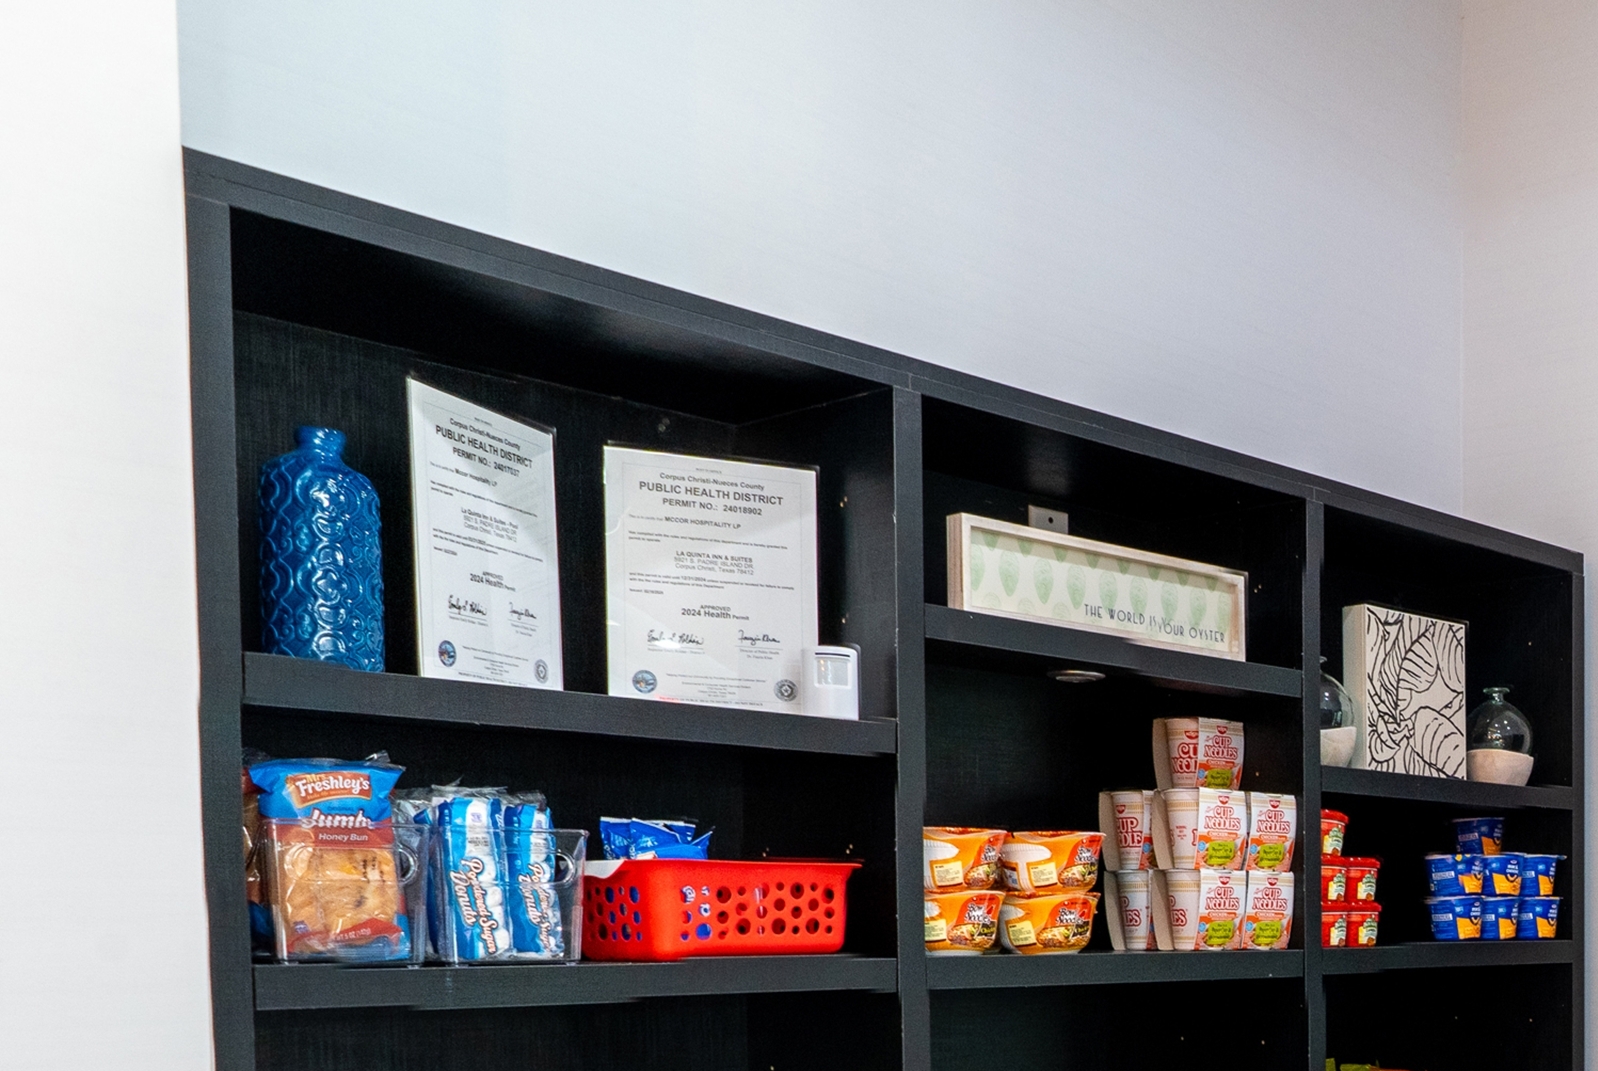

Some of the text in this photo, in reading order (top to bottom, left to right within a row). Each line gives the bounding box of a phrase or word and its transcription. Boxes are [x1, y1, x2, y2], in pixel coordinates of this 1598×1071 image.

[436, 424, 533, 468] PUBLIC HEALTH DISTRICT
[453, 446, 477, 462] PERMIT
[660, 472, 765, 491] Corpus Christi-Nueces County
[639, 481, 783, 505] PUBLIC HEALTH DISTRICT
[662, 498, 697, 508] PERMIT
[723, 504, 763, 516] 24018902
[690, 518, 731, 528] HOSPITALITY
[686, 551, 711, 559] QUINTA
[681, 608, 702, 617] 2024
[703, 610, 731, 620] Health
[700, 604, 731, 612] APPROVED
[1084, 603, 1103, 620] THE
[1109, 609, 1146, 626] WORLD
[1188, 626, 1226, 644] OYSTER
[1212, 735, 1232, 748] CUP
[1178, 742, 1199, 758] CU
[1203, 745, 1239, 760] NOODLES
[295, 776, 370, 797] Freshley's
[1213, 805, 1235, 819] CUP
[1265, 809, 1285, 823] CUP
[1204, 815, 1241, 831] NOODLES
[1256, 819, 1292, 834] NOODLES
[318, 833, 369, 843] Honey Bun
[1214, 886, 1234, 899] CUP
[1262, 887, 1282, 899] CUP
[1205, 896, 1240, 911] NOODLES
[1252, 897, 1288, 911] NOODLES
